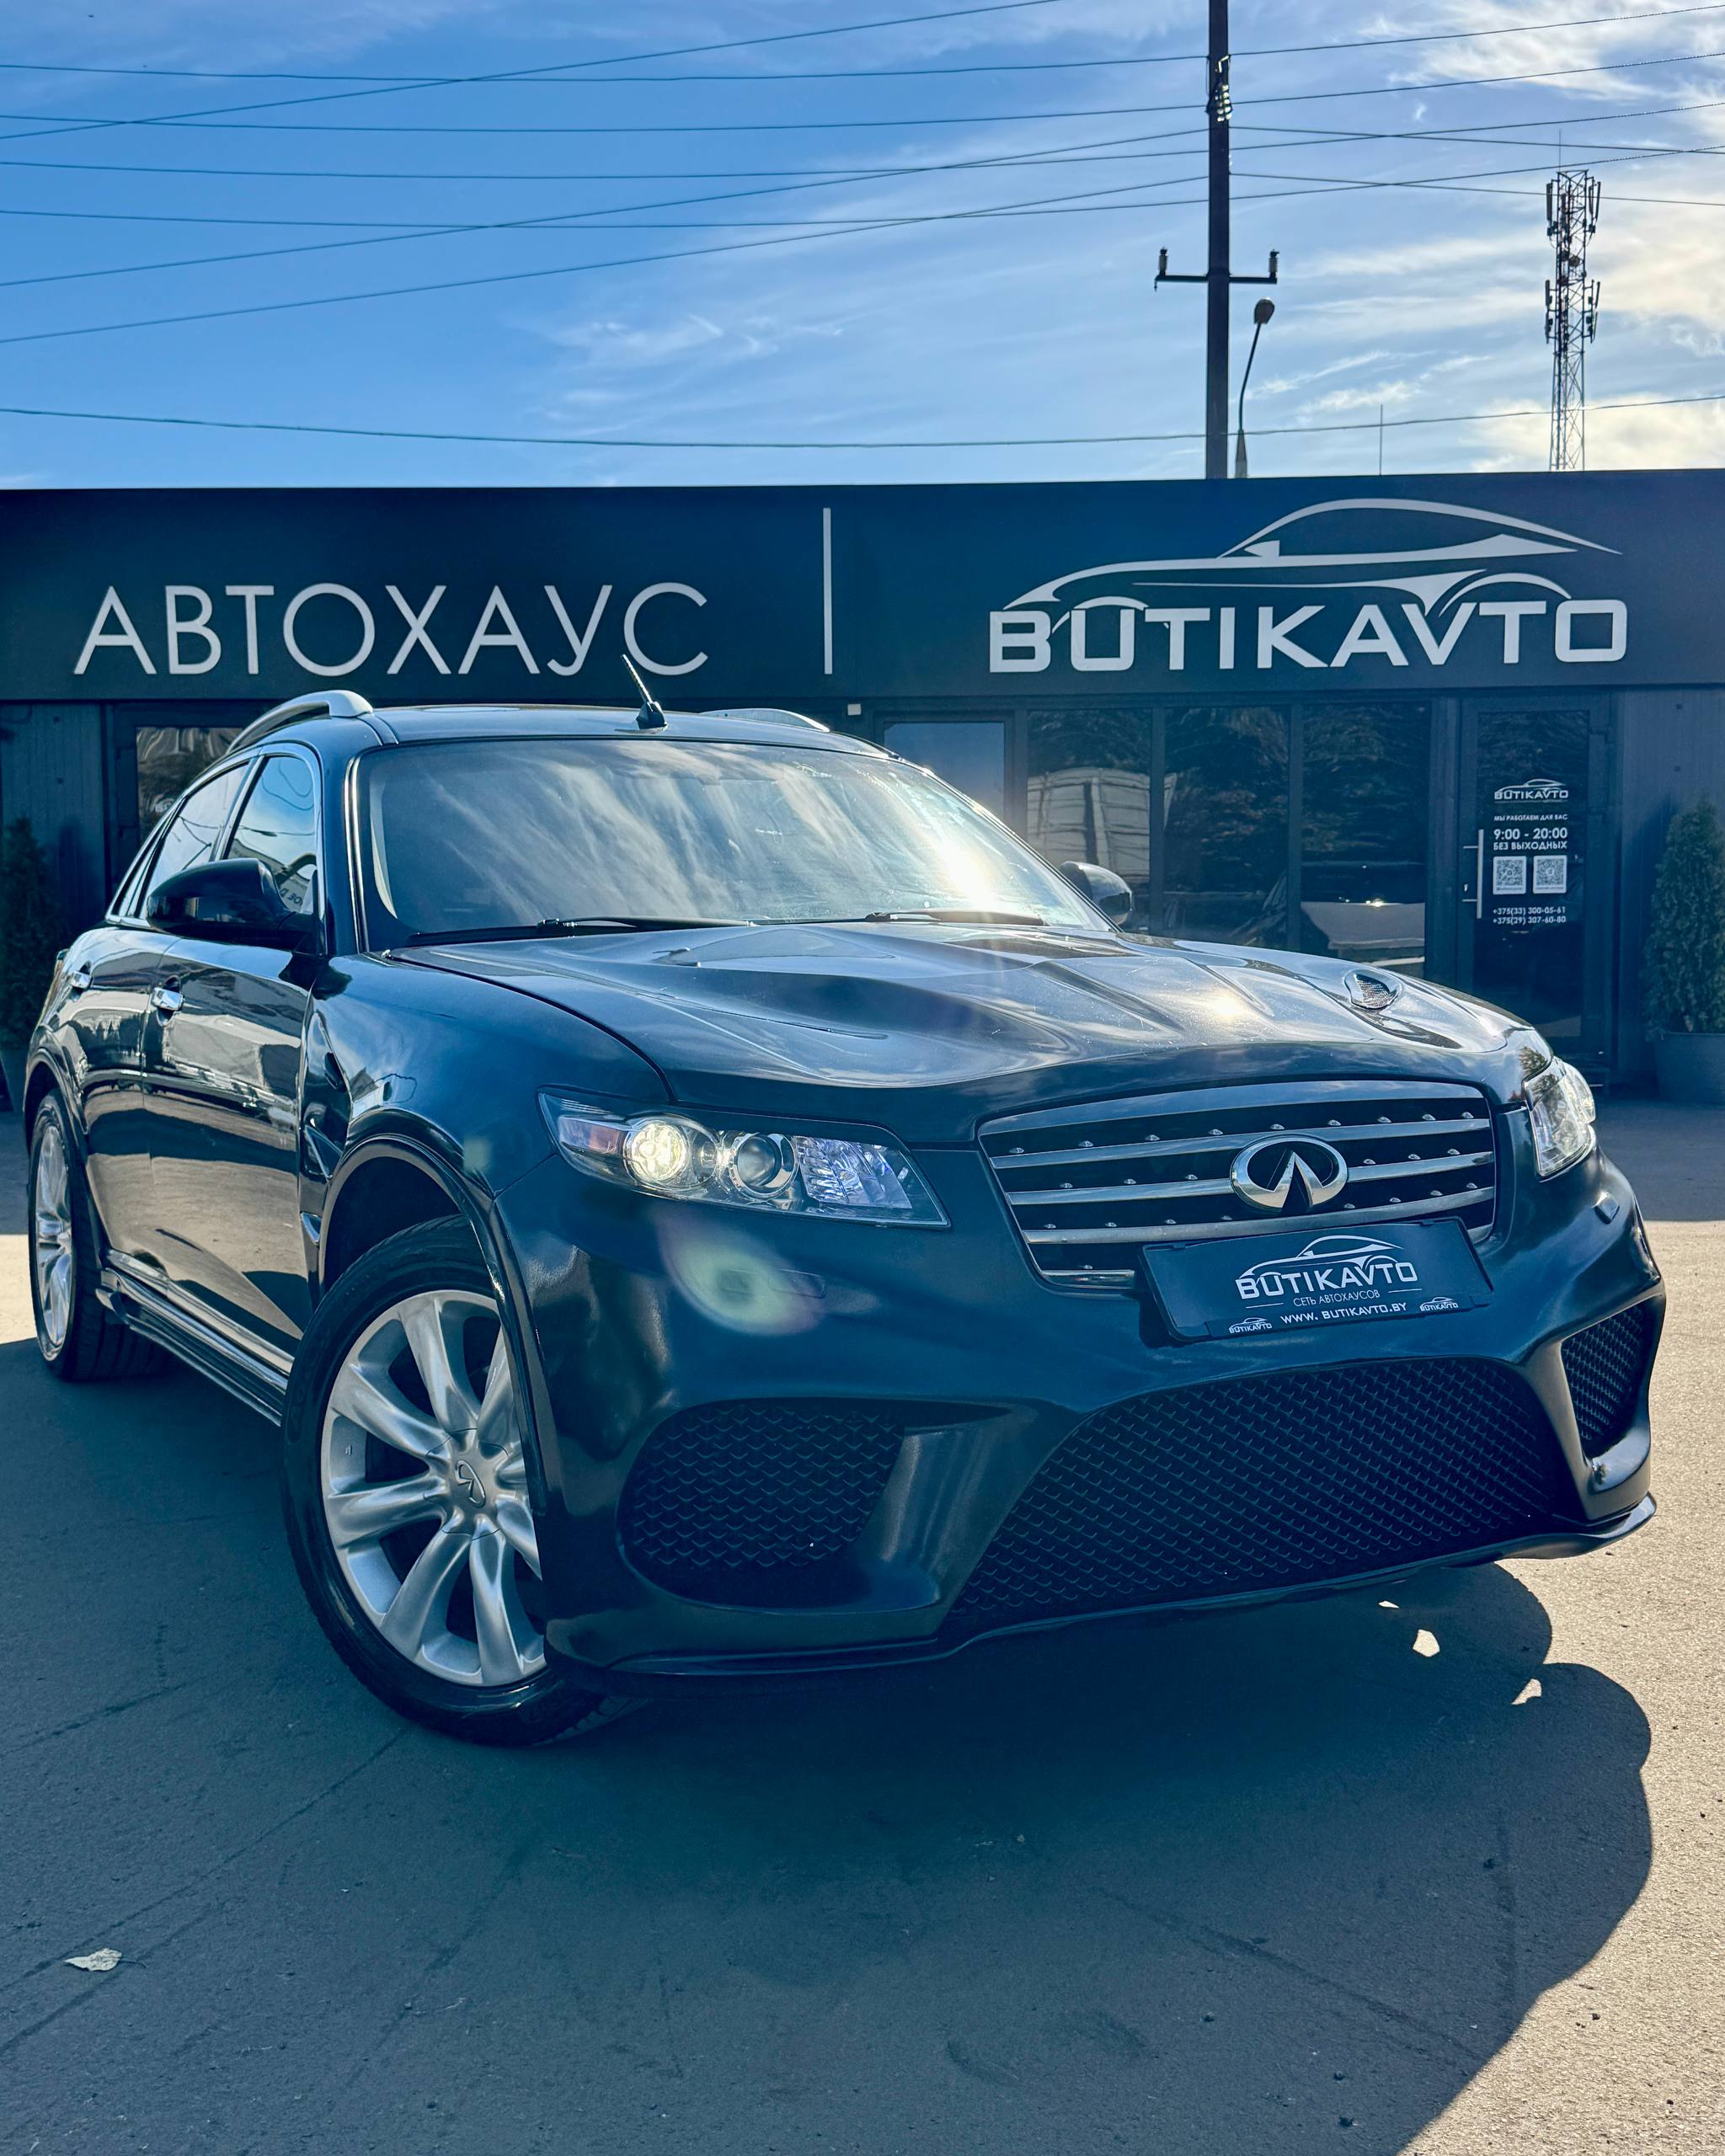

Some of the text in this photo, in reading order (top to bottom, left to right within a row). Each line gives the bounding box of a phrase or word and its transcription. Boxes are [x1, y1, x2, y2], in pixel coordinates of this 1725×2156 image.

[72, 581, 709, 676] АВТОХАУС
[989, 598, 1629, 674] BUTIKAVTO
[1494, 789, 1569, 800] BUTIKAVTO
[1493, 829, 1520, 840] 9:00
[1533, 827, 1567, 840] 20:00
[1493, 841, 1567, 851] БЕЗ ВЫХОДНЫХ
[1235, 1261, 1418, 1299] BUTIKAVTO
[1293, 1289, 1381, 1306] СЕТЬ АВТОХАУСОВ
[1419, 1302, 1458, 1312] BUTIKAVTO
[1228, 1322, 1273, 1334] BUTIKAVTO
